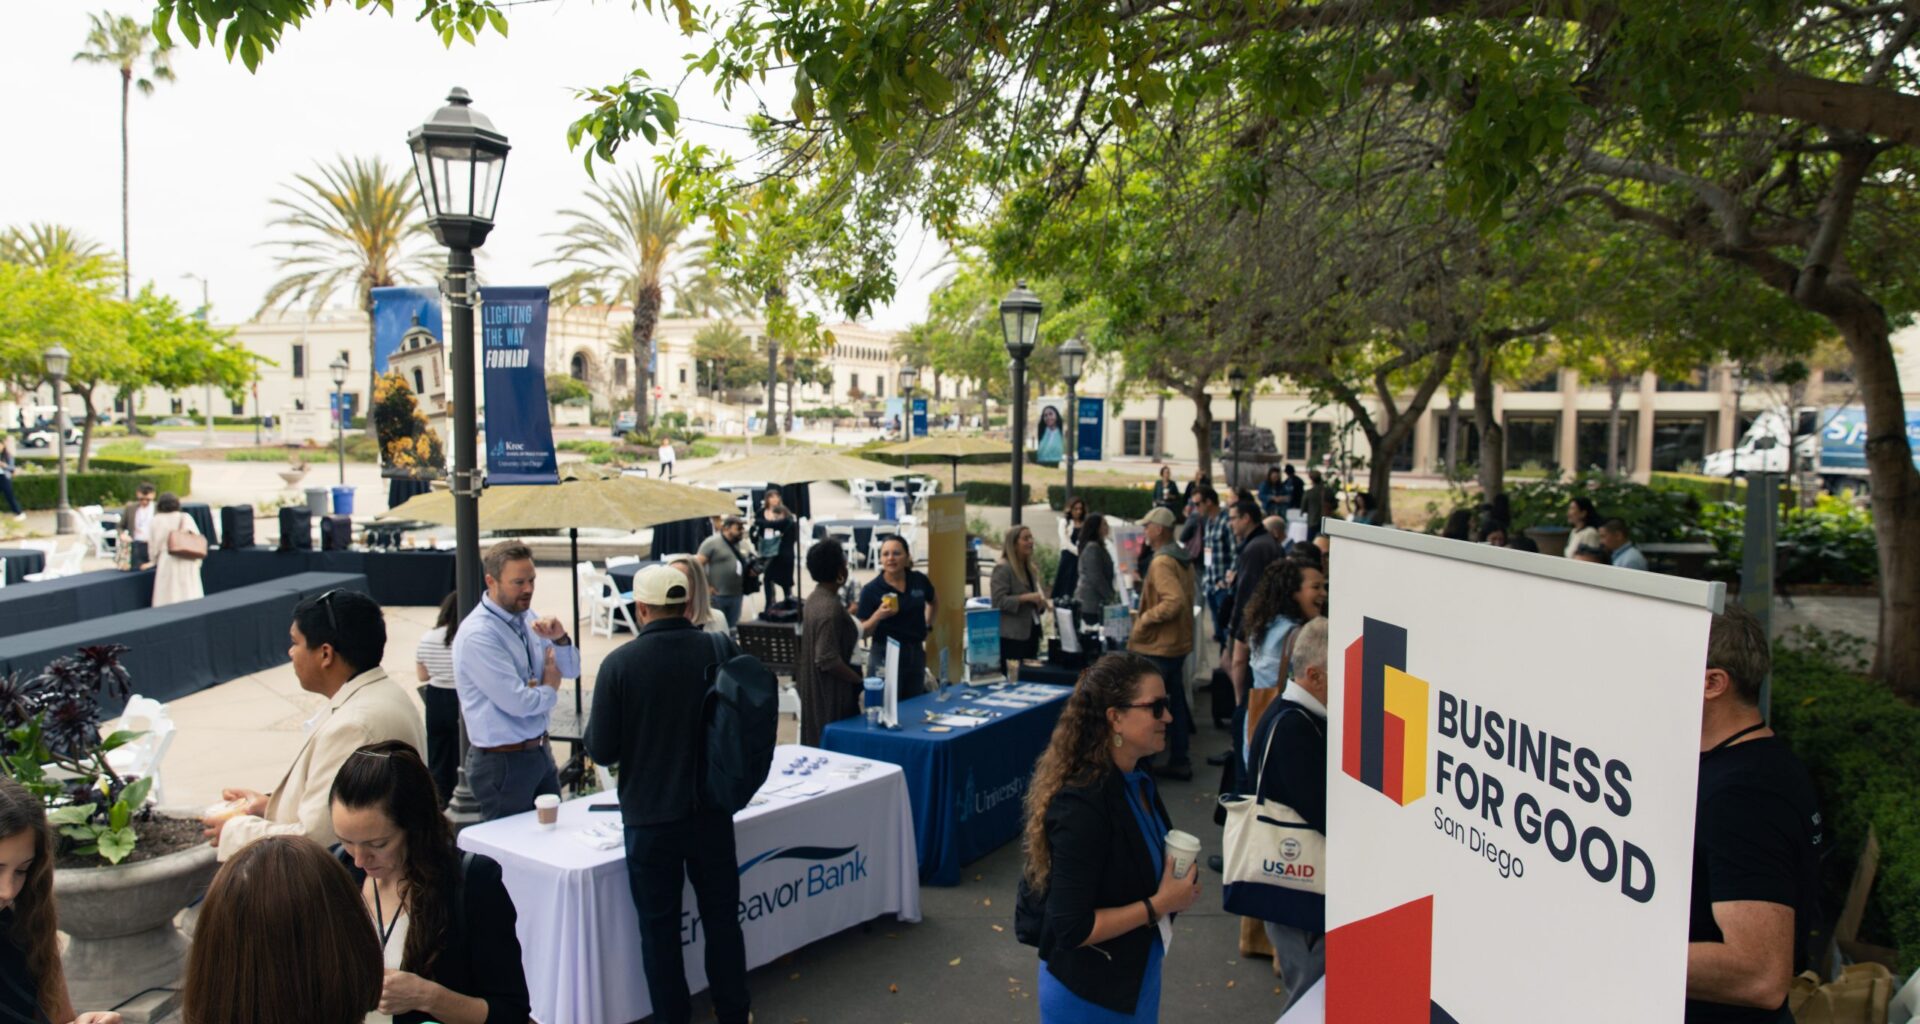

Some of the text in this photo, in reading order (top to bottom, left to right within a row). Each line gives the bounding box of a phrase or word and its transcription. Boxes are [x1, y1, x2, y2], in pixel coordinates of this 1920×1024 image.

[485, 305, 532, 325] LIGHTING
[485, 327, 525, 346] THE WAY
[486, 349, 529, 368] FORWARD
[1437, 690, 1632, 817] BUSINESS
[1434, 806, 1524, 878] San Diego
[1436, 750, 1656, 903] FOR GOOD
[1263, 859, 1314, 878] USAID
[680, 851, 867, 947] Eneavor Bank
